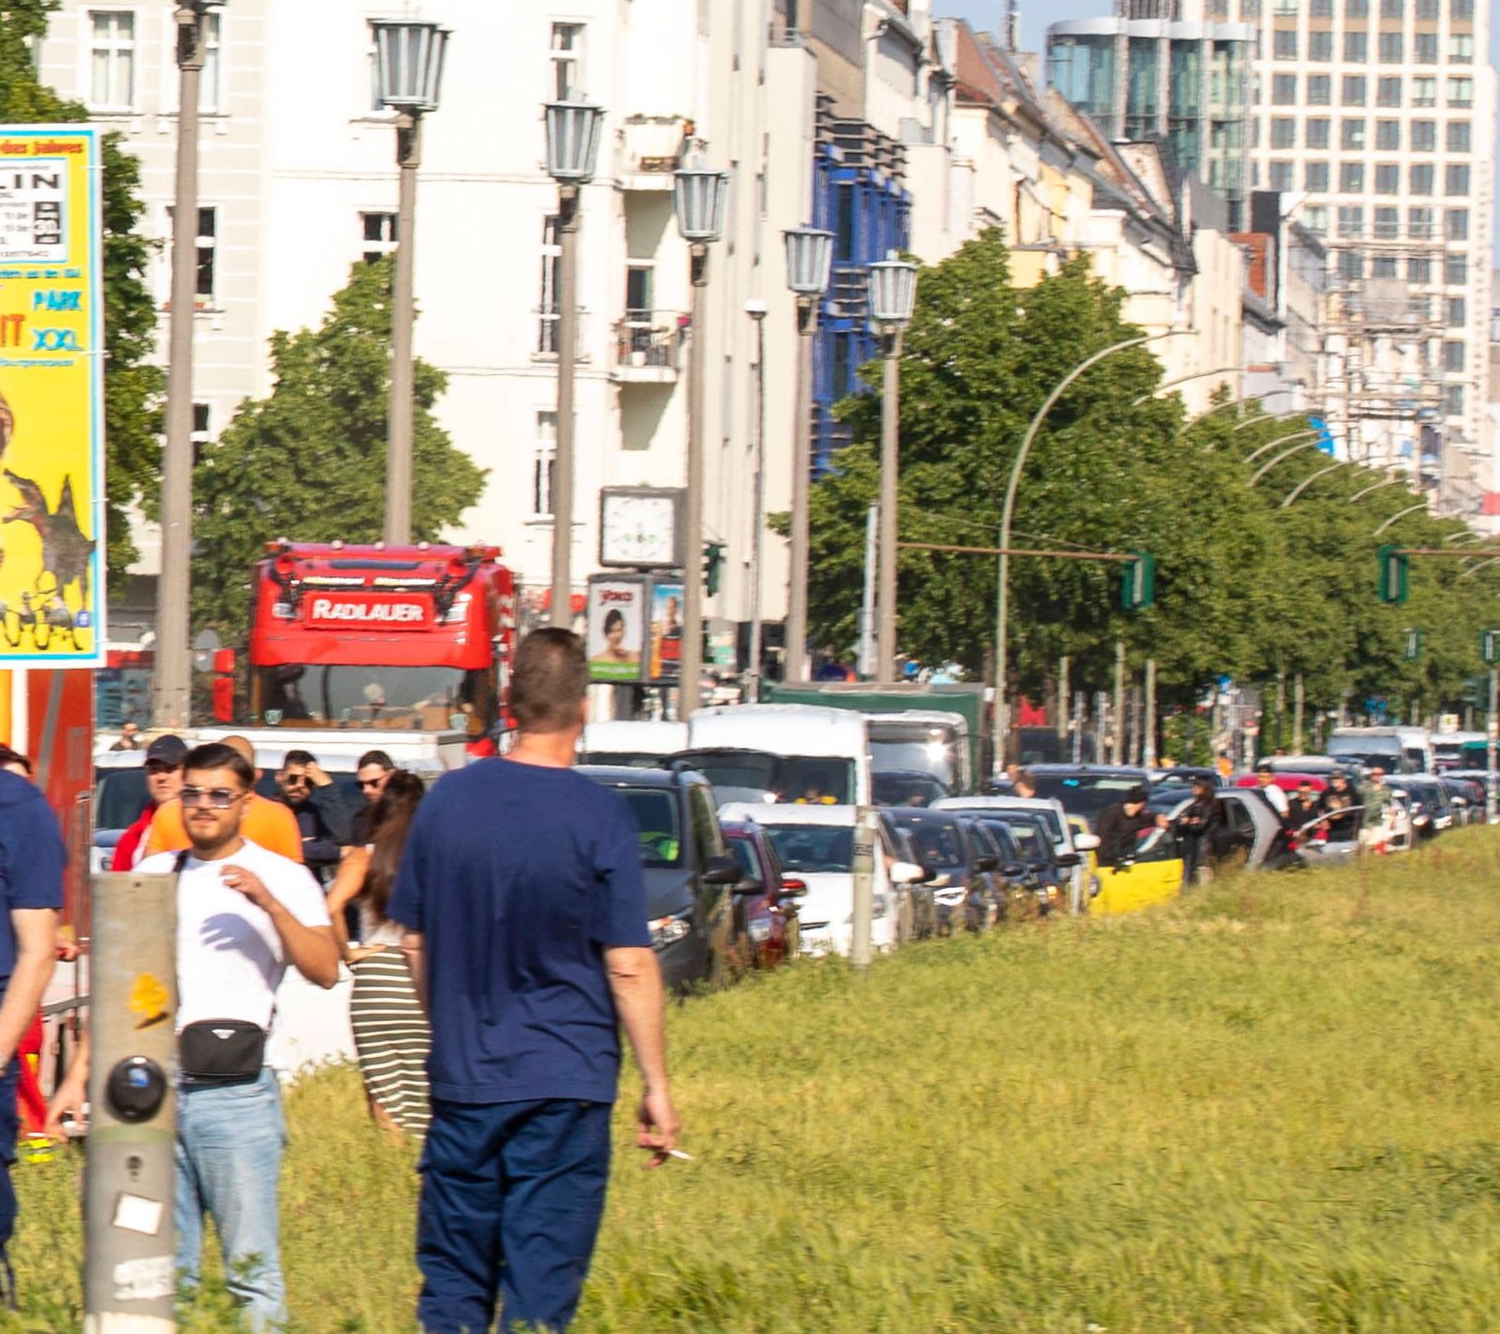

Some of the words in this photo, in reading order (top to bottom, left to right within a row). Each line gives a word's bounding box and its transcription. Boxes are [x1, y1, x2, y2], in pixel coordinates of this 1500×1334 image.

[32, 291, 83, 311] PARK
[32, 328, 84, 352] XXL
[312, 599, 424, 622] RADLAUER
